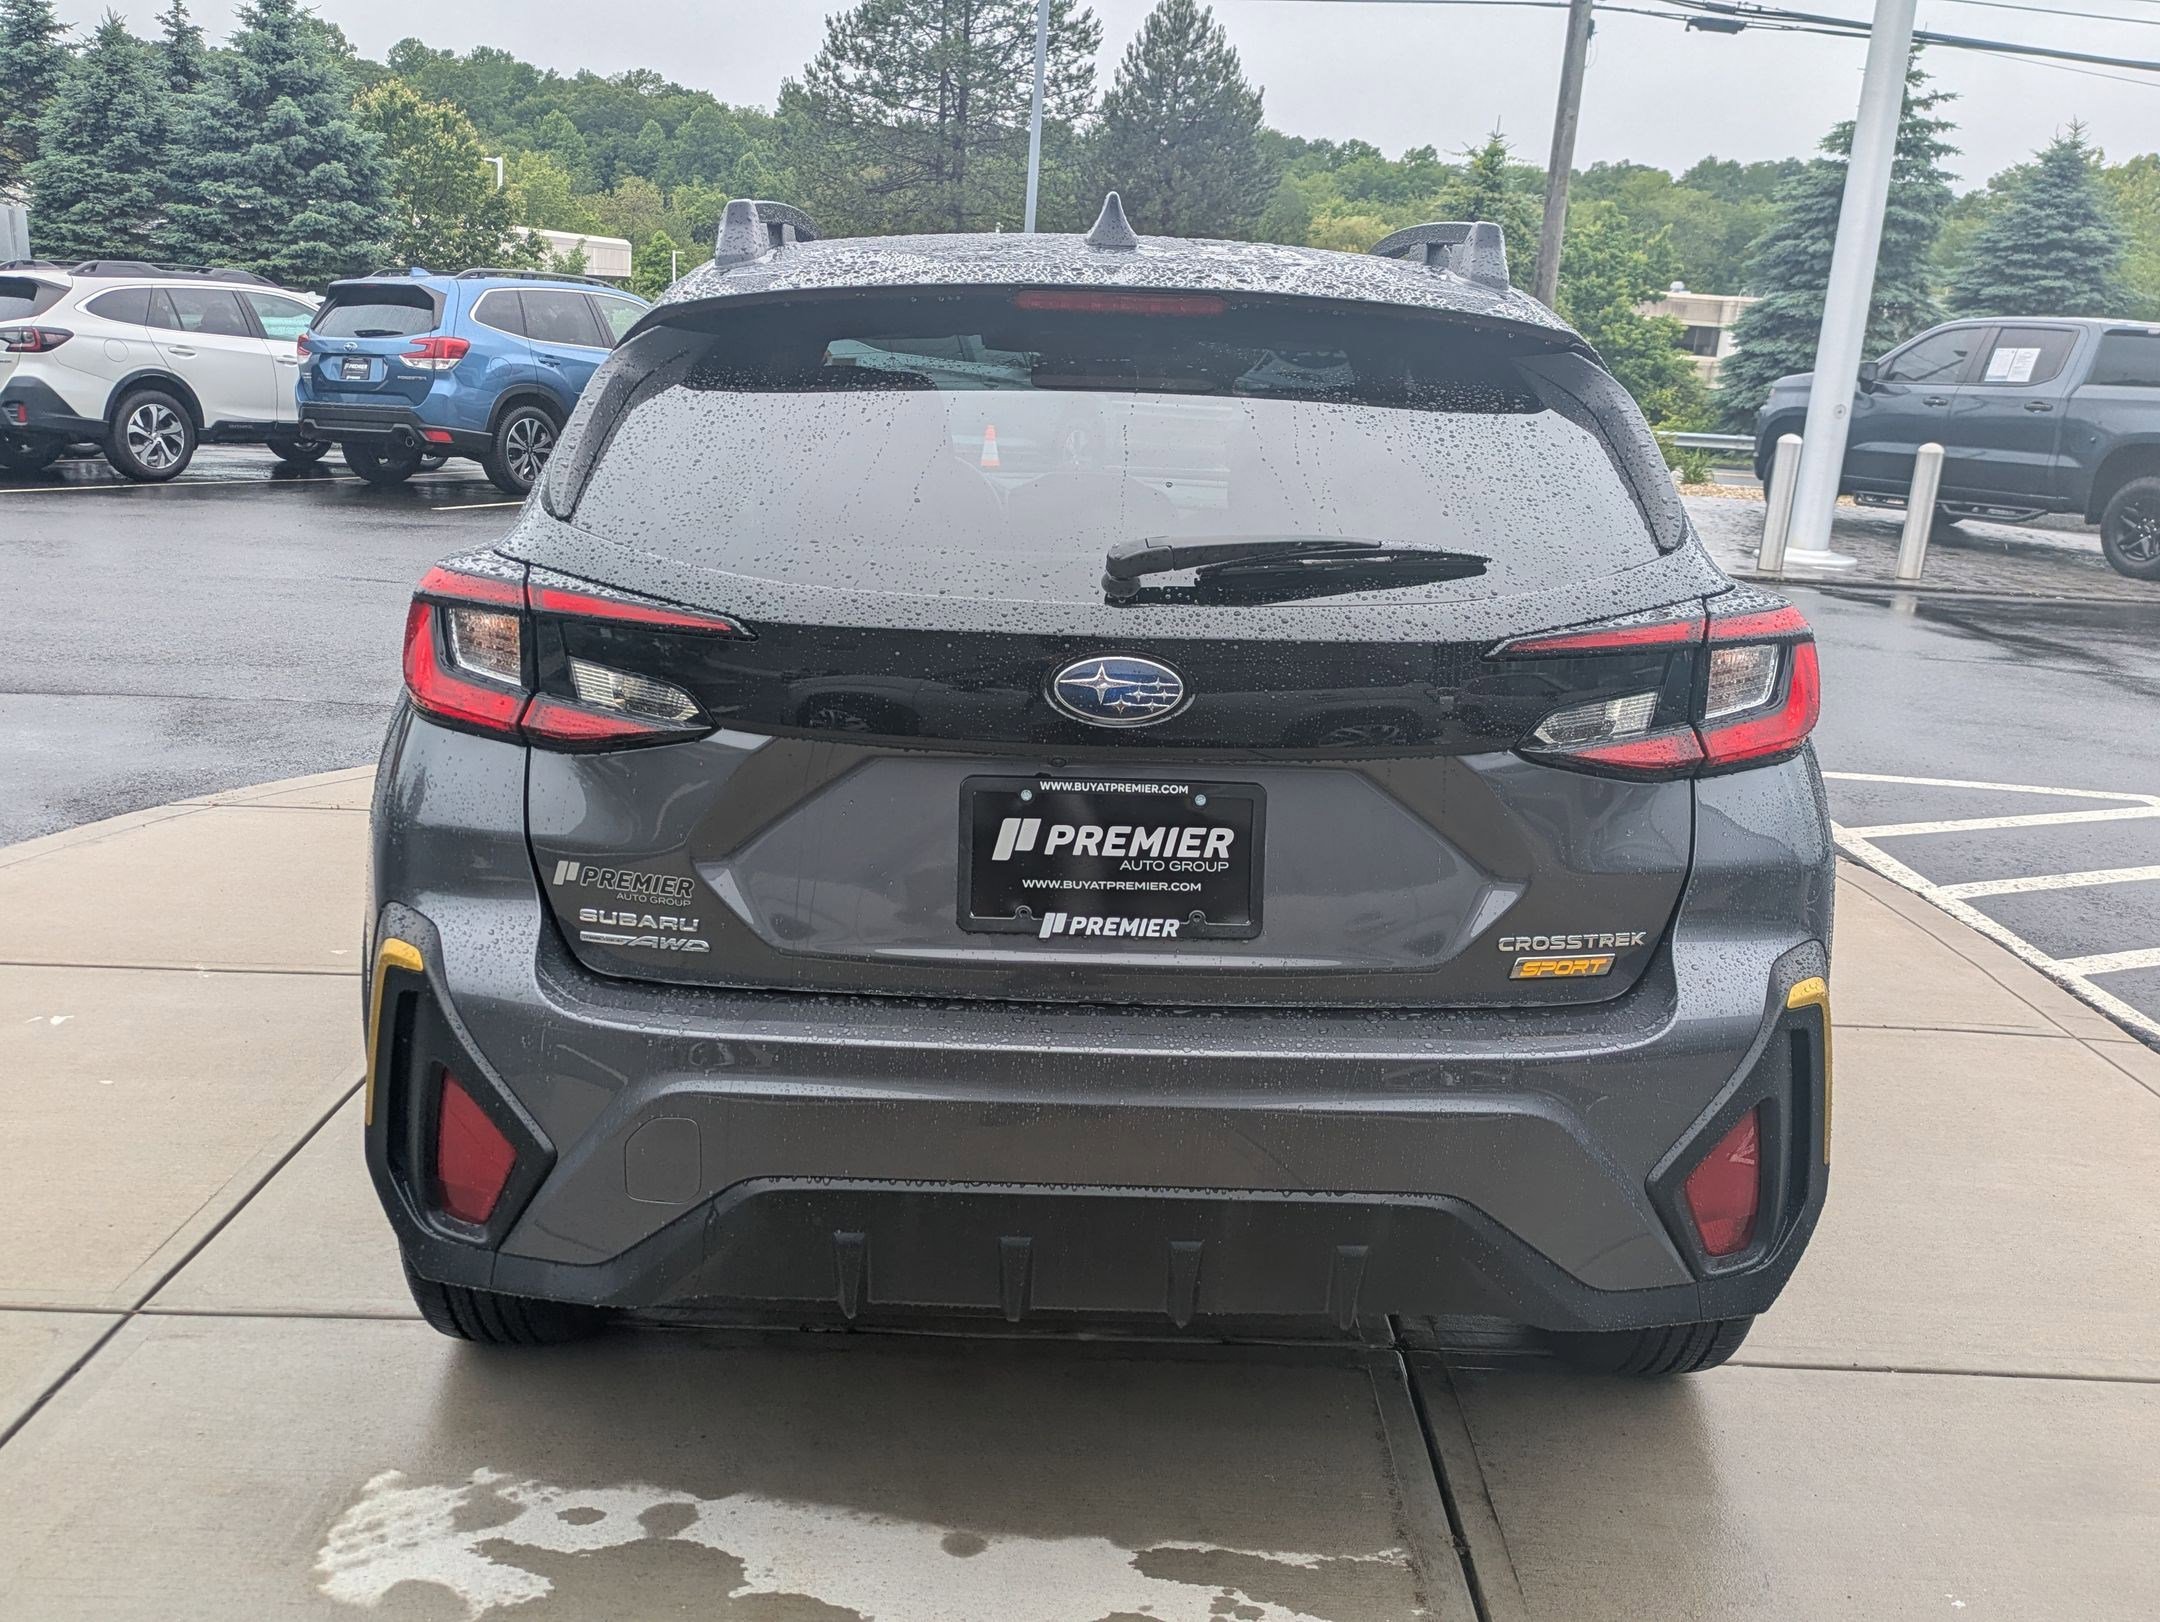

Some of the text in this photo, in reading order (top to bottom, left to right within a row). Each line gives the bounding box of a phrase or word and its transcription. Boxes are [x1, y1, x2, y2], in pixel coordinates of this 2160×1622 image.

[1040, 781, 1188, 794] WWW.BUYATPREMIER.COM
[1044, 825, 1235, 858] PREMIER
[1119, 860, 1229, 873] AUTO GROUP
[580, 866, 695, 898] PREMIER
[1022, 879, 1201, 892] WWW.BUYATPREMIER.COM
[616, 892, 691, 907] AUTO GROUP
[579, 908, 699, 932] SUBARU
[1069, 916, 1180, 937] PREMIER
[628, 935, 710, 953] AWD
[1498, 931, 1646, 952] CROSSTREK
[1520, 959, 1608, 976] SPORT
